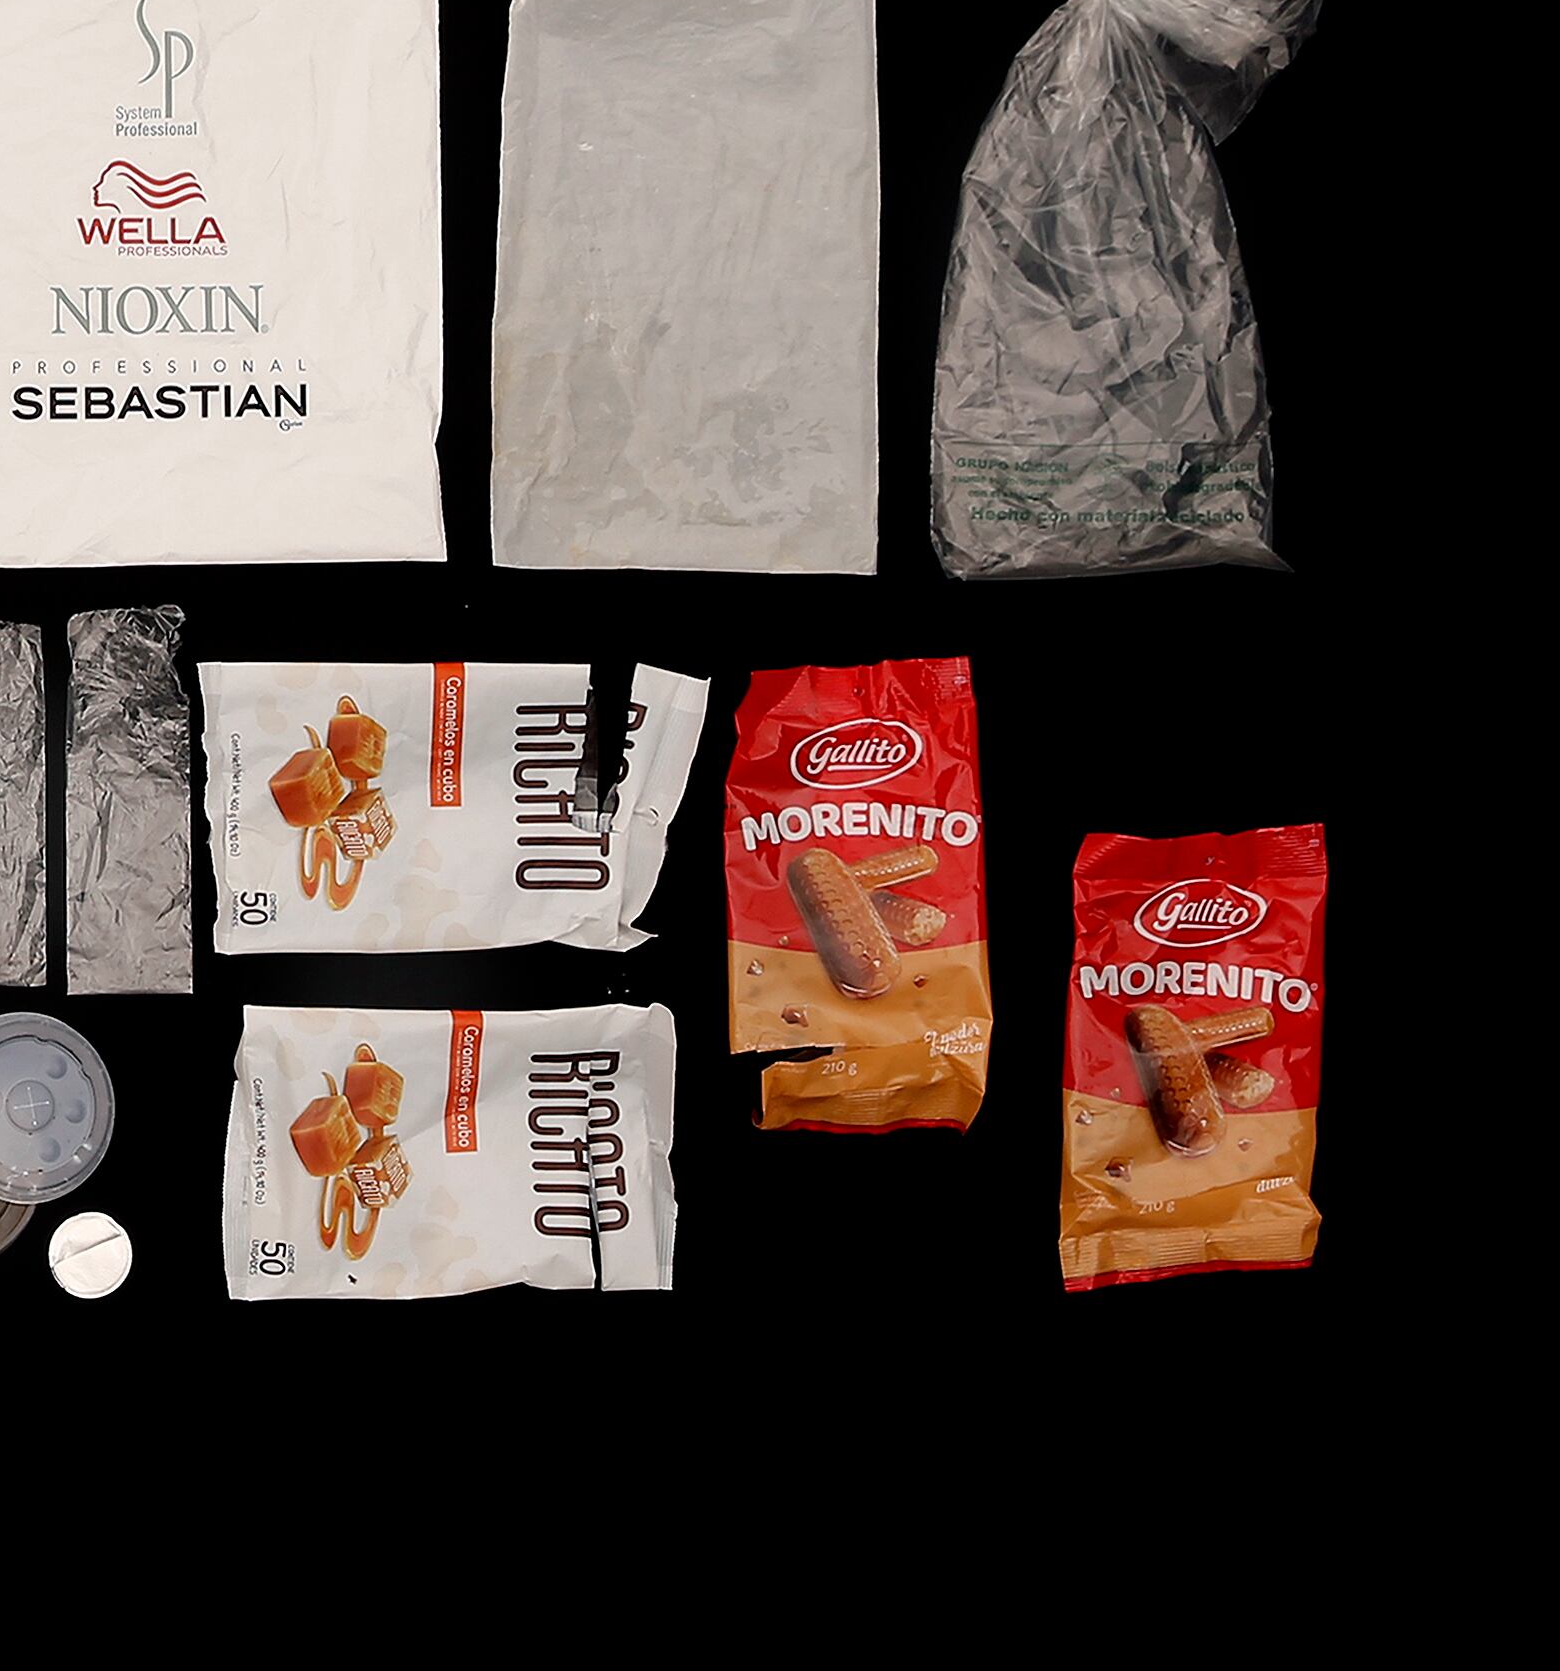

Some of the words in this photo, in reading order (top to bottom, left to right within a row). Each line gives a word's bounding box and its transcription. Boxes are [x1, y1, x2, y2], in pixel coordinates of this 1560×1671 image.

[116, 106, 162, 121] System
[116, 122, 197, 137] Professional
[77, 217, 227, 246] WELLA
[118, 245, 228, 257] PROFESSIONALS
[50, 284, 264, 335] NIOXIN
[11, 359, 308, 374] PROFESSIONAL
[11, 384, 308, 420] SEBASTIAN
[444, 676, 462, 747] Caramelos
[445, 750, 455, 768] en
[806, 737, 907, 776] Gallito
[443, 771, 455, 803] cubo
[741, 800, 979, 851] MORENITO
[240, 891, 268, 926] 50
[1153, 890, 1251, 931] Gallito
[1079, 961, 1312, 1013] MORENITO
[460, 1025, 479, 1095] Caramelos
[822, 1061, 846, 1075] 210
[458, 1097, 468, 1113] en
[458, 1115, 471, 1148] cubo
[260, 1241, 287, 1275] 50
